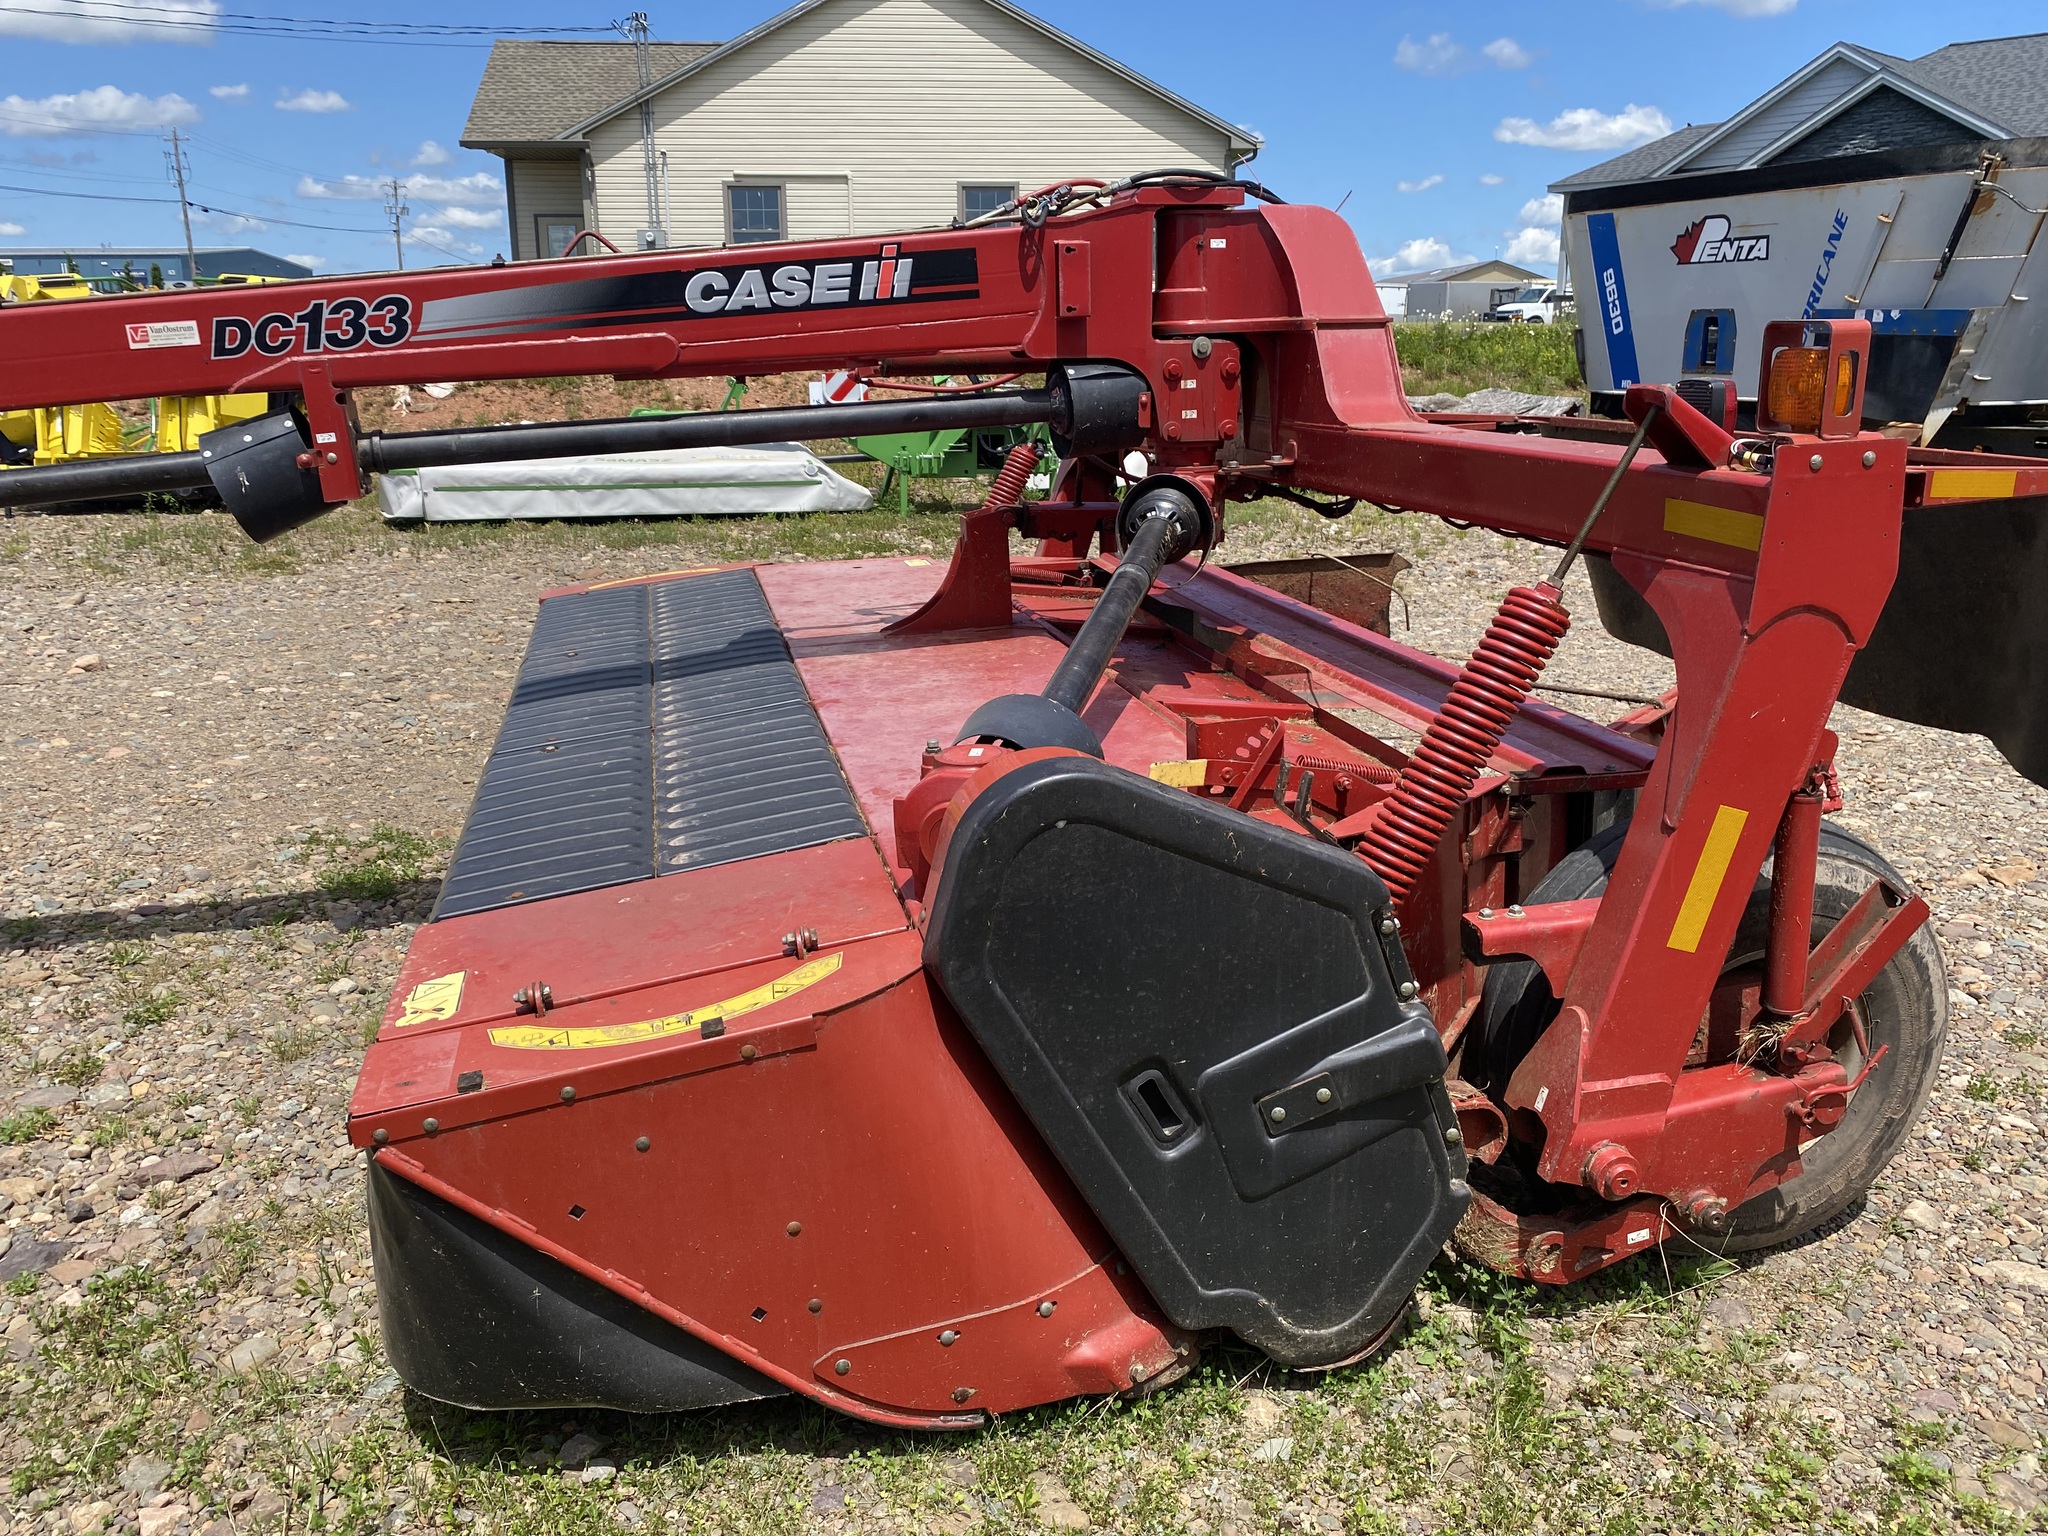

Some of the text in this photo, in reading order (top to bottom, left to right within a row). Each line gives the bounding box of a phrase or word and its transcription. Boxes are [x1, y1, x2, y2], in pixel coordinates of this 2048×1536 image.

[1689, 214, 1768, 263] PENTA
[684, 262, 853, 313] CASE
[1603, 267, 1624, 335] 9630
[211, 294, 412, 360] DC133
